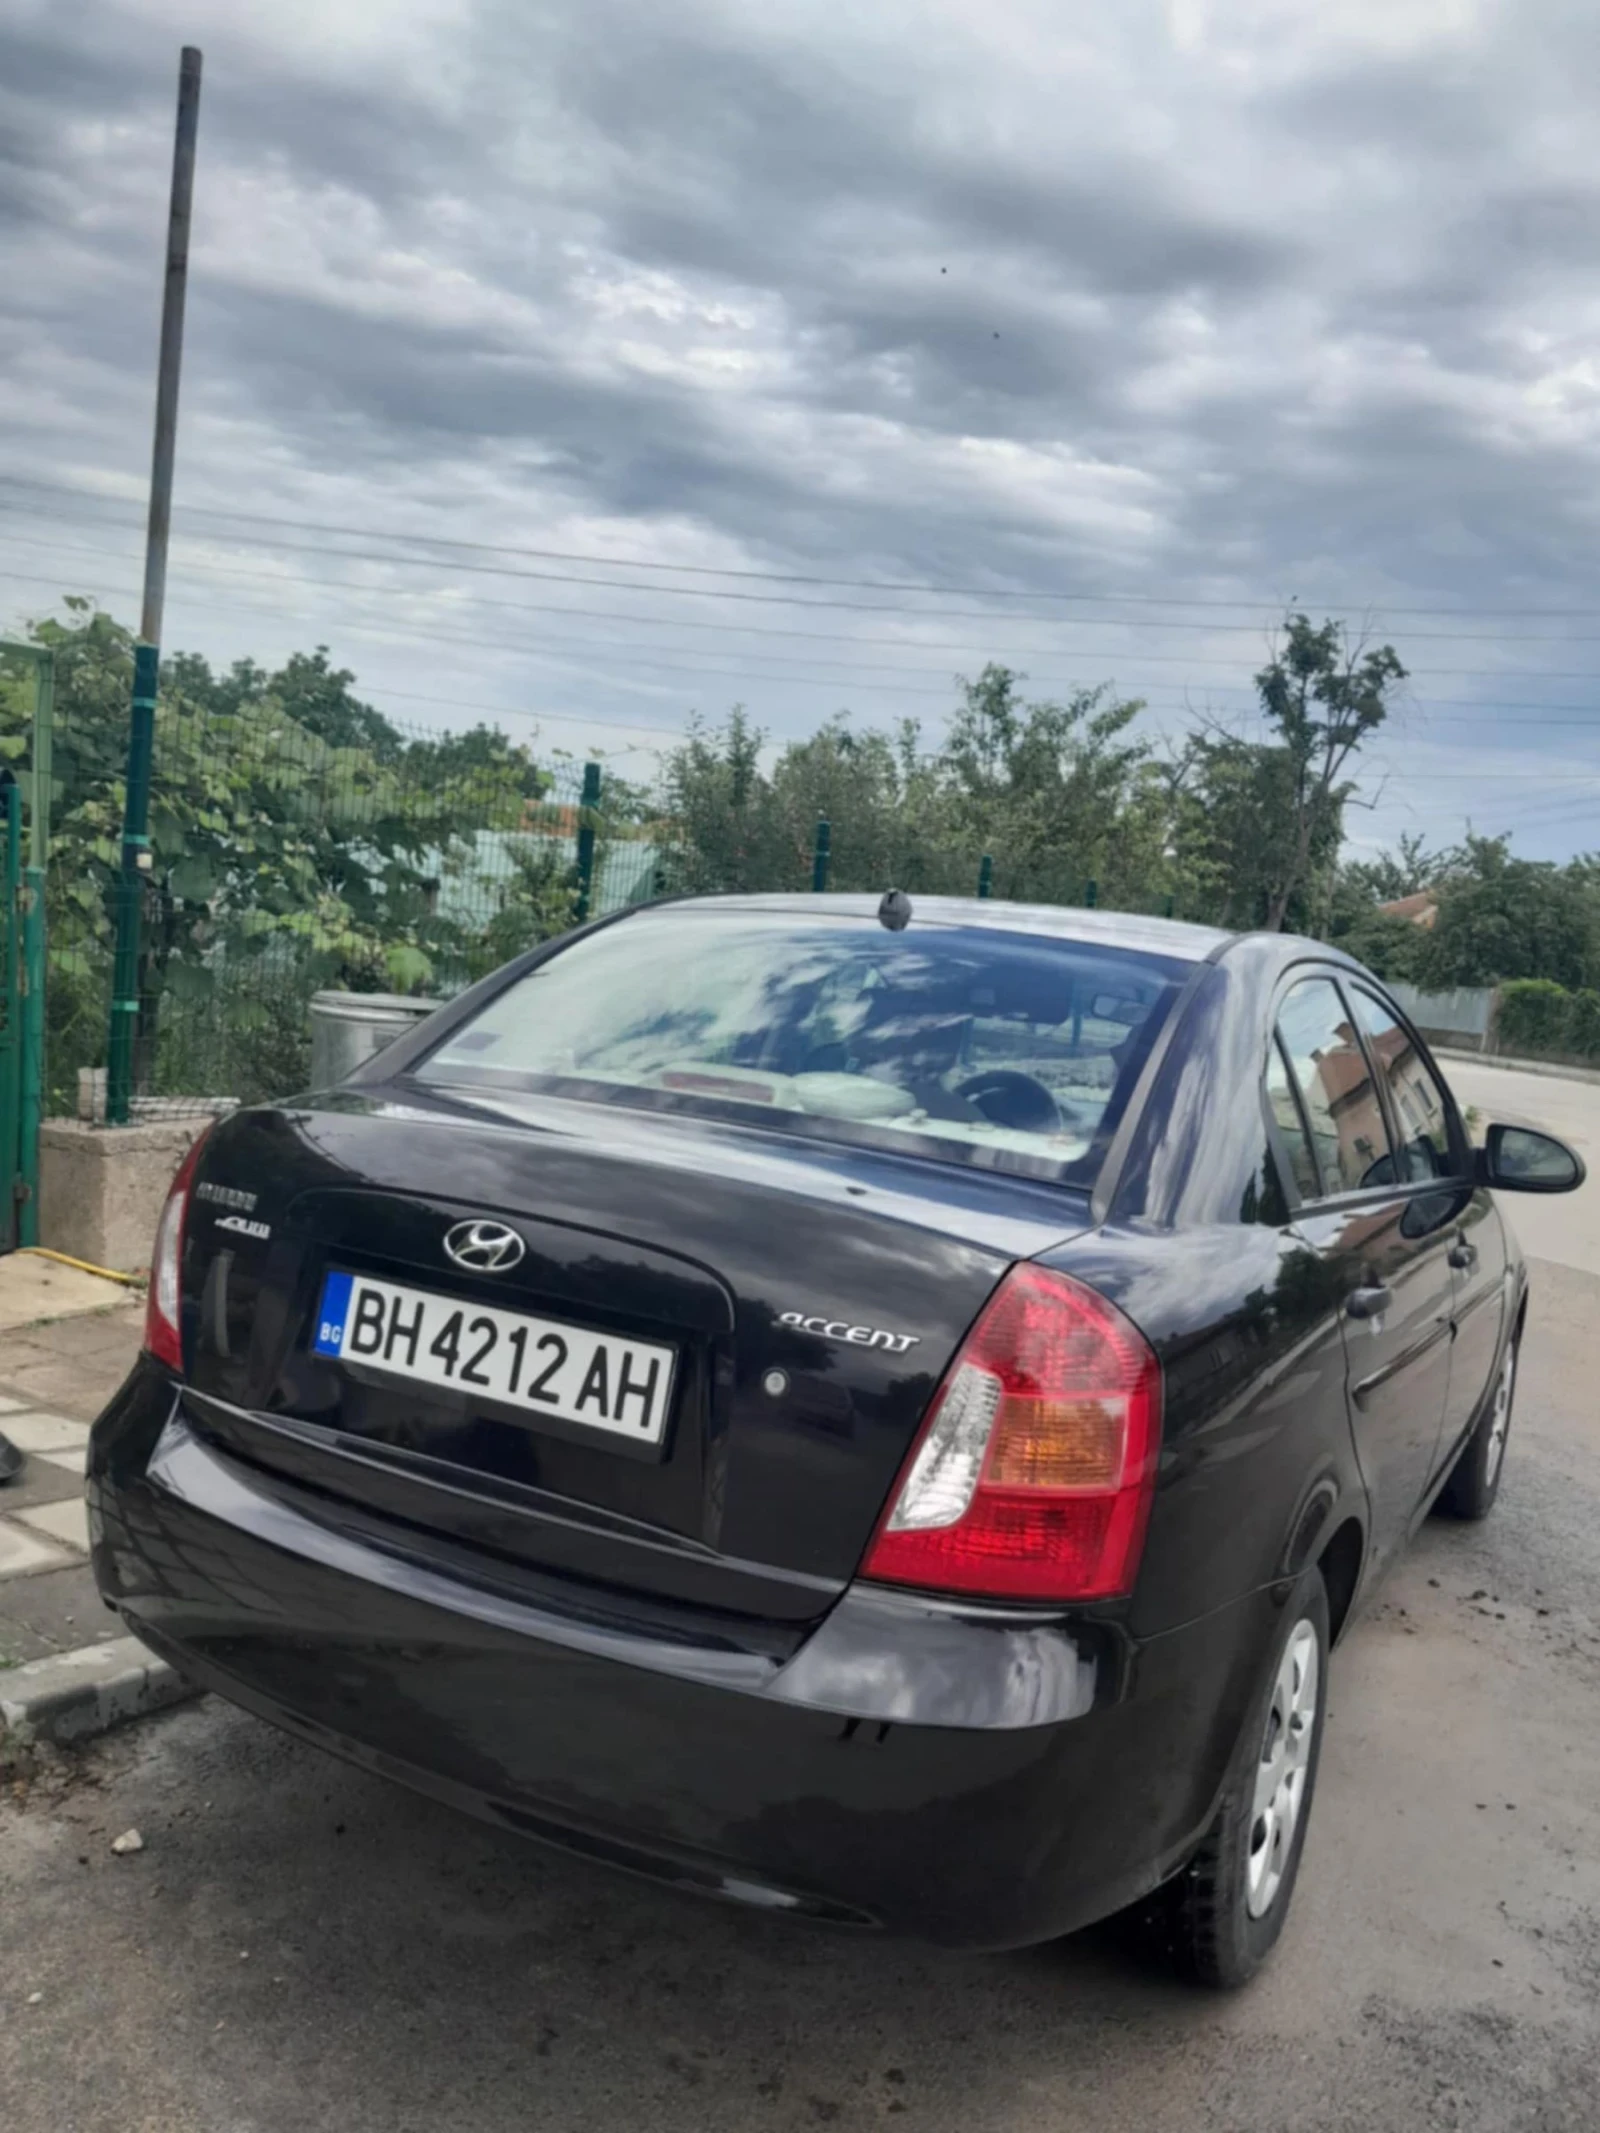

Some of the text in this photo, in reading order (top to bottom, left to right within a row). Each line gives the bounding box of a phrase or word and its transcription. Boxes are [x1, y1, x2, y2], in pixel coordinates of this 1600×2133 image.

[319, 1322, 342, 1344] BG
[771, 1311, 920, 1353] ACCENT
[350, 1288, 660, 1429] BH 4212 AH
